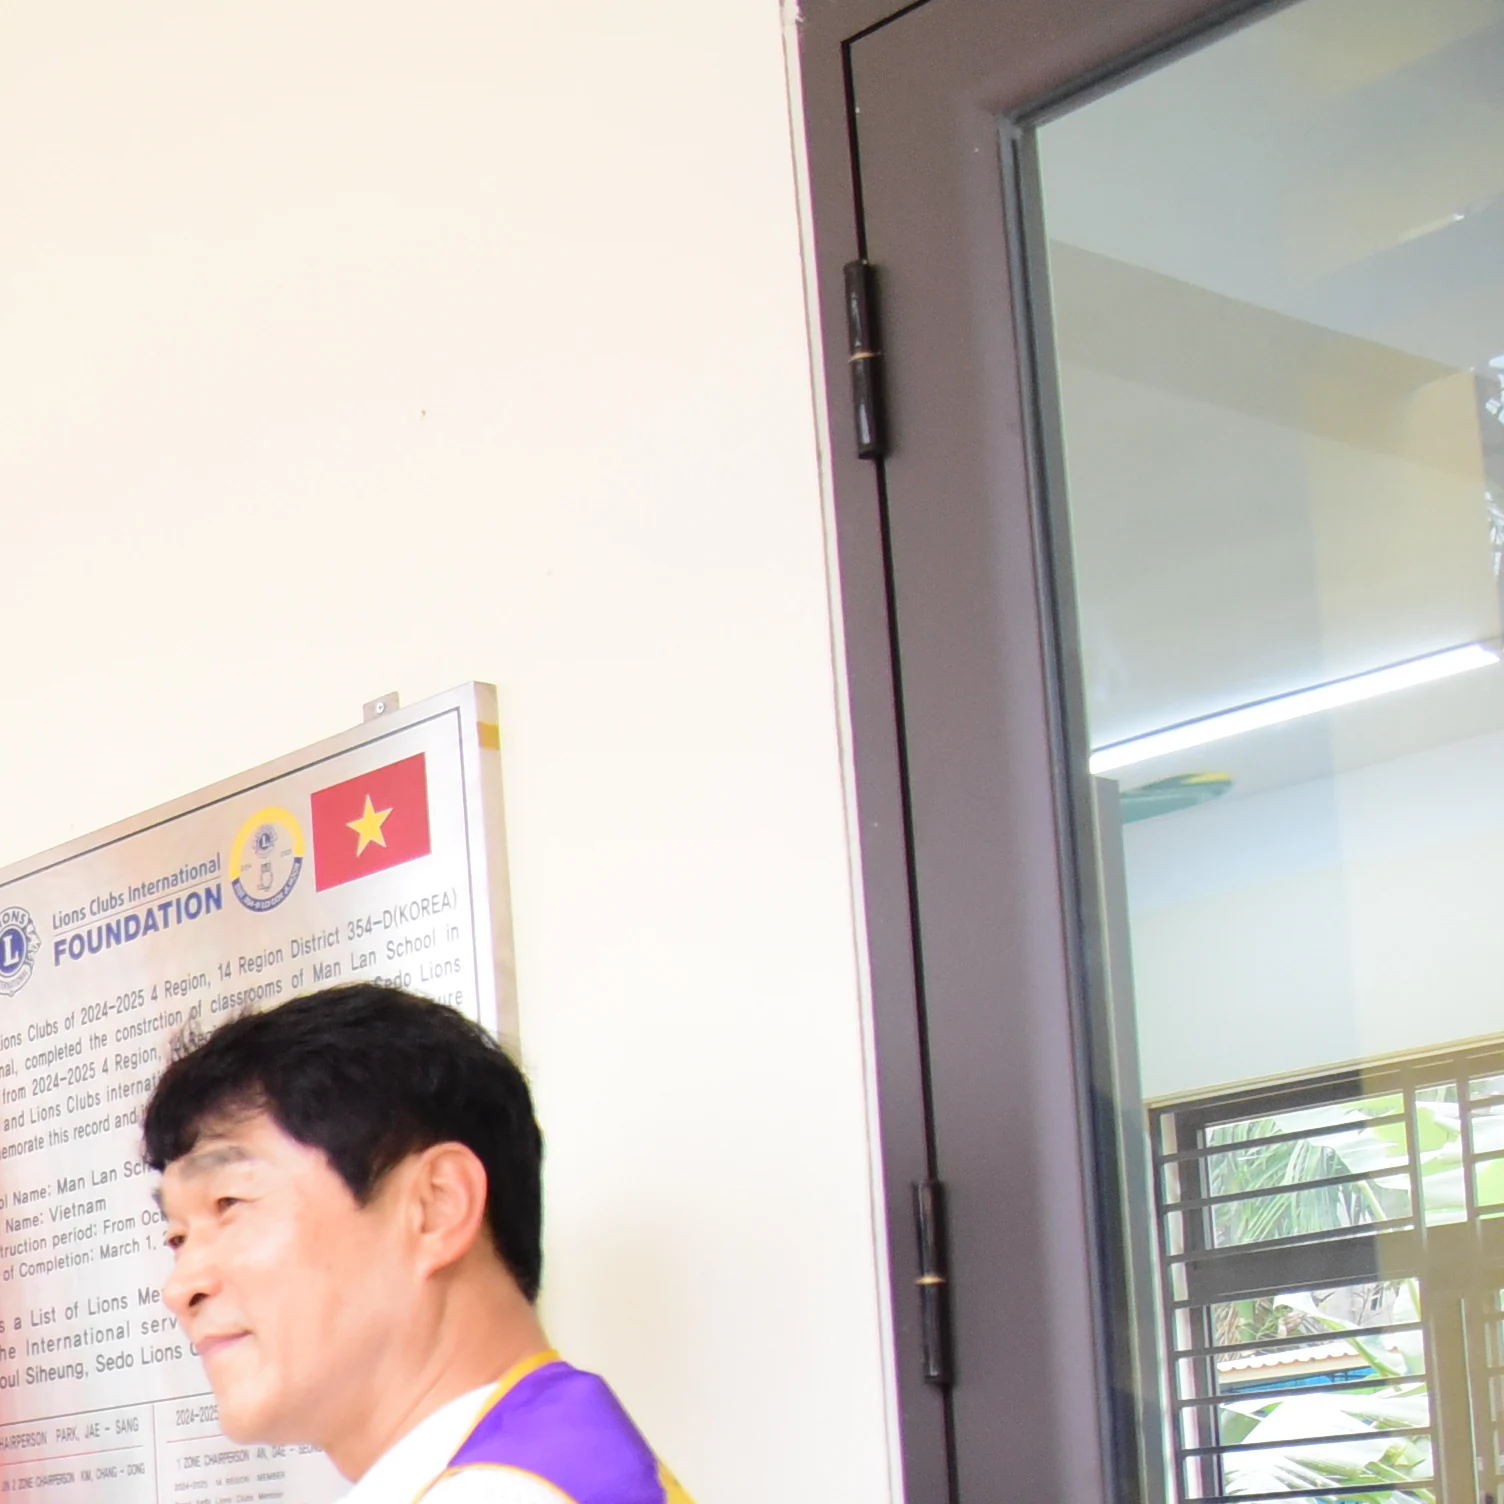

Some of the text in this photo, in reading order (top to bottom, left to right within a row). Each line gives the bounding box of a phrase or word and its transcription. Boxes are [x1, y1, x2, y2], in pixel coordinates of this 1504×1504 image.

[52, 852, 221, 930] Lions Clubs International
[54, 883, 222, 967] FOUNDATION
[2, 934, 20, 967] L
[27, 1020, 59, 1042] Clubs
[64, 1011, 75, 1031] of
[80, 989, 145, 1026] 2024-2025
[150, 984, 158, 1002] 4
[164, 973, 211, 999] Region,
[217, 960, 232, 981] 14
[238, 948, 284, 976] Region
[290, 927, 340, 959] District
[346, 884, 458, 944] 354-D(KOREA)
[24, 1037, 82, 1071] completed
[89, 1032, 108, 1051] the
[115, 1010, 184, 1043] constrction
[209, 979, 283, 1014] classrooms
[291, 967, 304, 989] of
[312, 961, 342, 983] Man
[350, 950, 377, 971] Lan
[386, 929, 436, 960] School
[446, 920, 459, 942] in
[2, 1086, 26, 1104] from
[32, 1061, 96, 1096] 2024-2025
[101, 1057, 109, 1074] 4
[114, 1047, 161, 1072] Region,
[420, 951, 462, 983] Lions
[48, 1127, 69, 1147] this
[73, 1114, 110, 1140] record
[114, 1106, 138, 1129] and
[13, 1184, 51, 1206] Name:
[57, 1177, 85, 1195] Man
[91, 1168, 117, 1186] Lan
[123, 1156, 148, 1178] Sch
[5, 1212, 44, 1233] Name:
[48, 1198, 106, 1223] Vietnam
[26, 1320, 130, 1356] International
[141, 1317, 177, 1335] serv
[25, 1362, 89, 1385] Siheung,
[96, 1350, 134, 1373] Sedo
[141, 1345, 183, 1365] Lions
